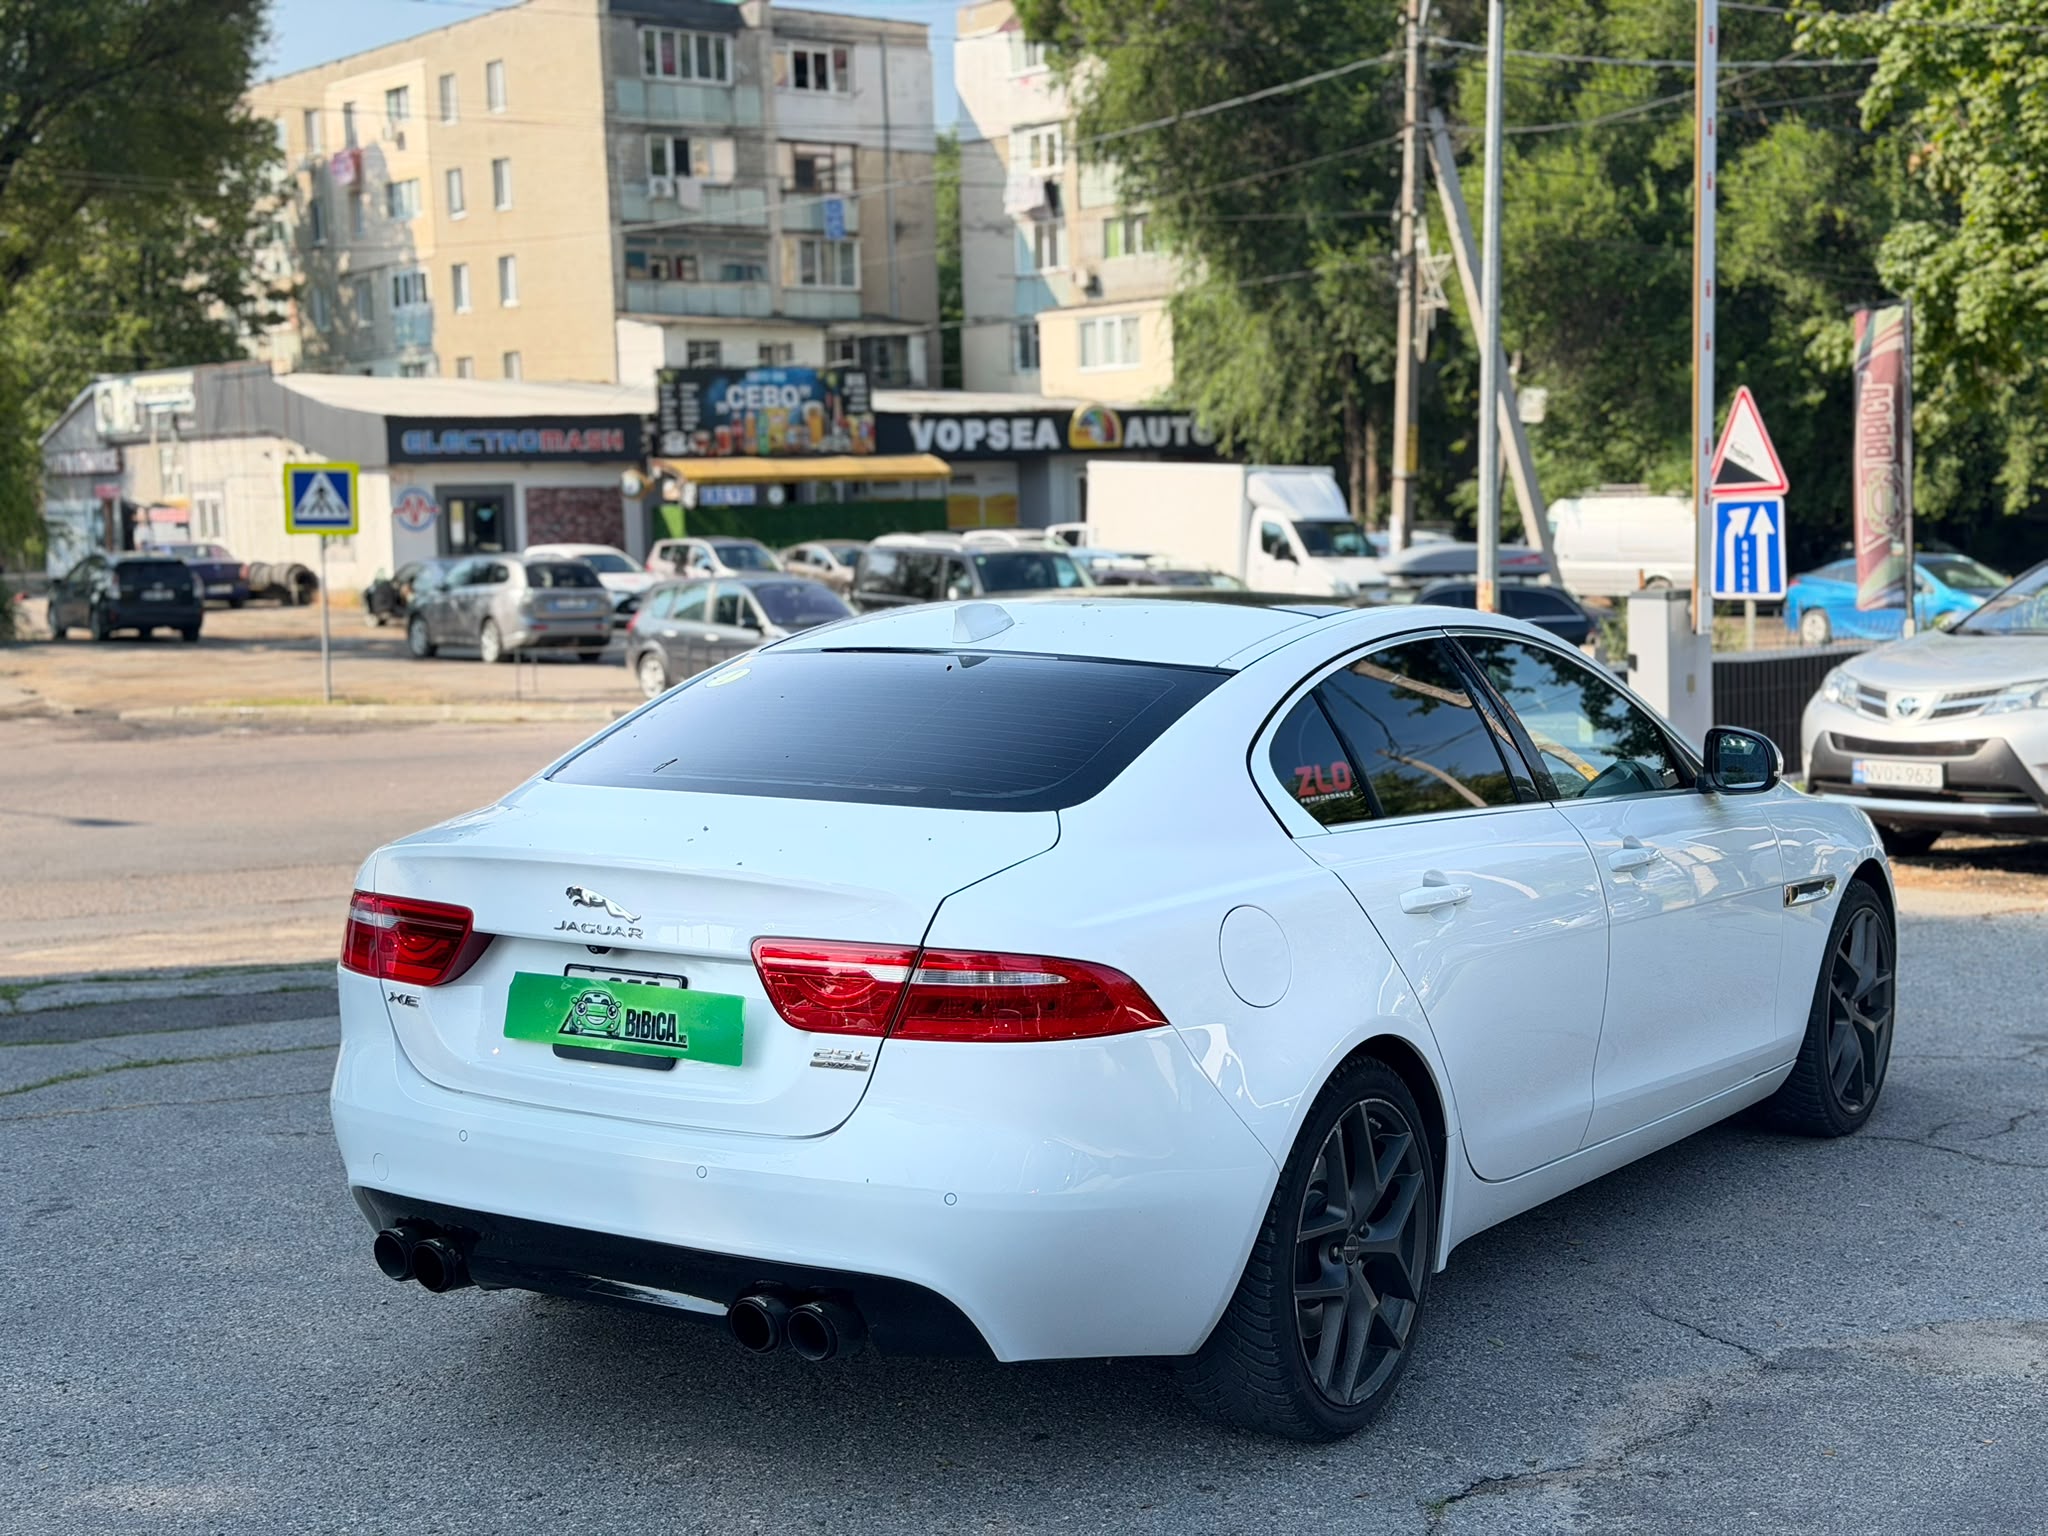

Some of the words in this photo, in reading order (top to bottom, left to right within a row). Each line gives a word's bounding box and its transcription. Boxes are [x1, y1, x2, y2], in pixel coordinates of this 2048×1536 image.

[908, 417, 1060, 450] VOPSEA
[1295, 761, 1352, 796] ZLO
[553, 920, 644, 939] JAGUAR
[388, 991, 421, 1008] XE
